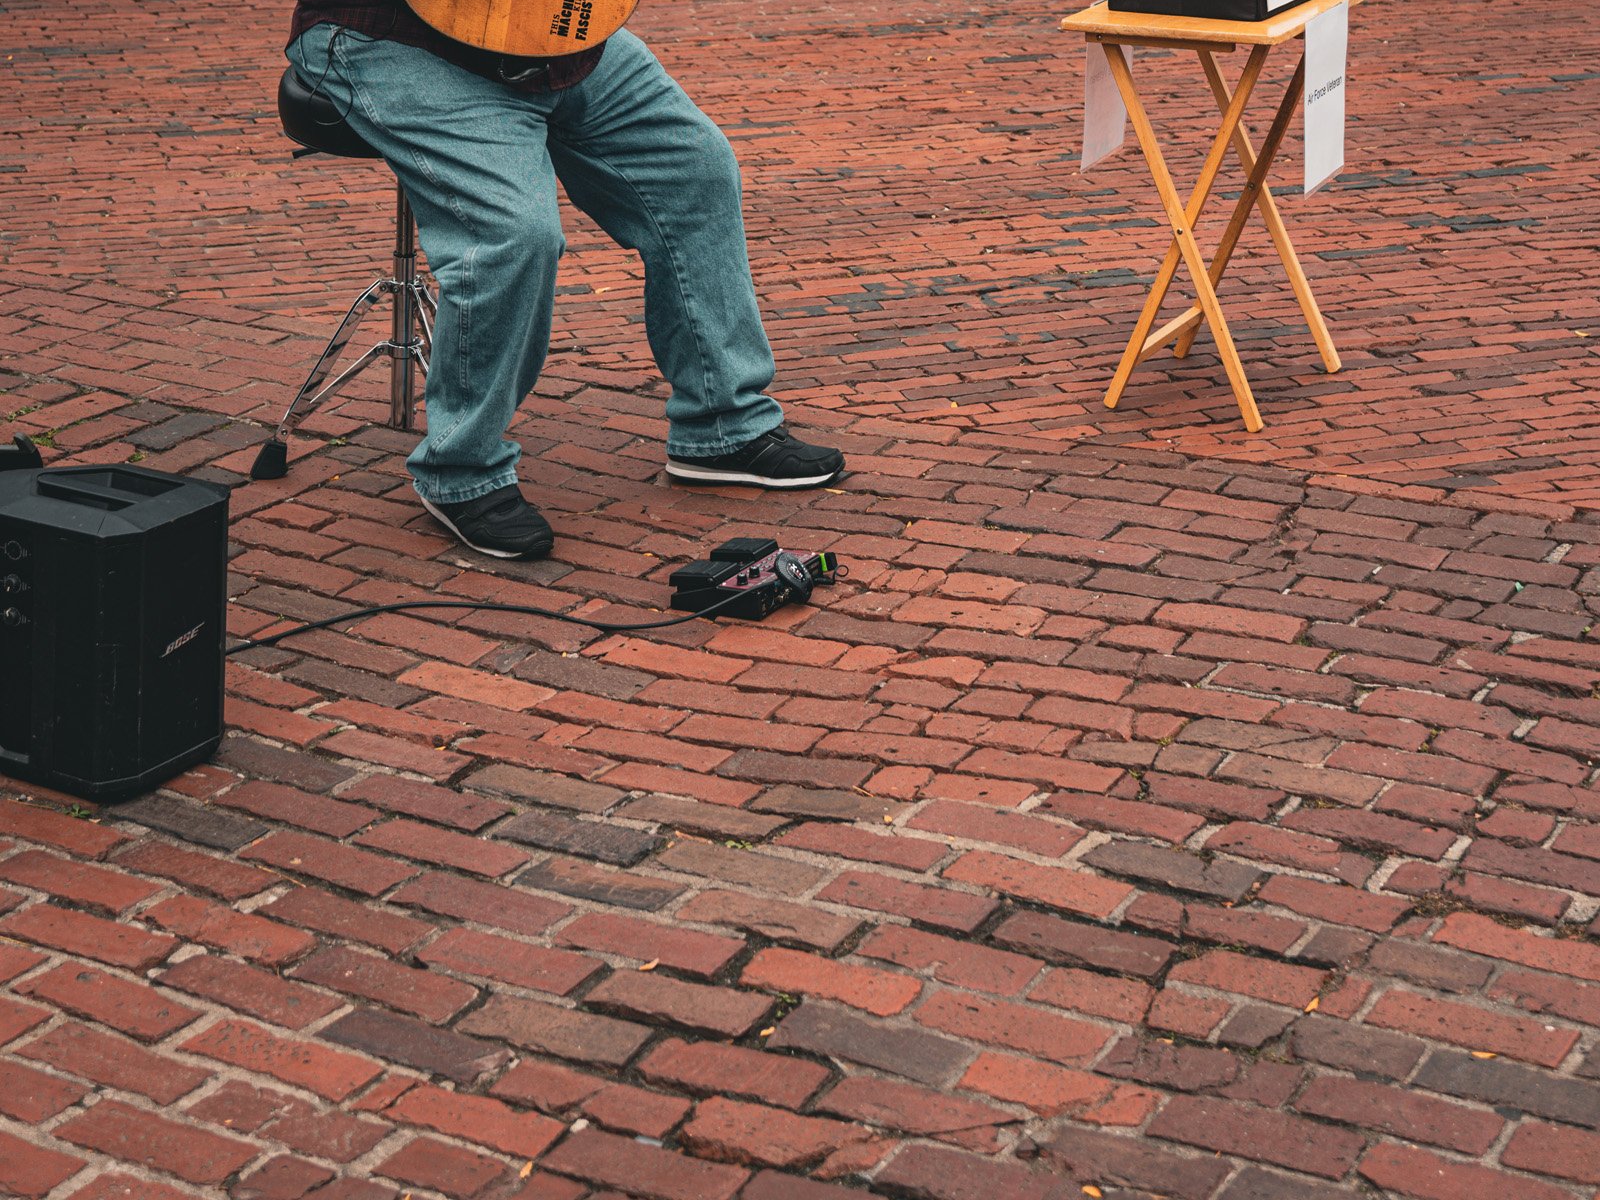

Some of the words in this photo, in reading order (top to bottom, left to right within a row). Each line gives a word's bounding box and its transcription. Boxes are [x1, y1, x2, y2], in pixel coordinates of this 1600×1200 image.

[550, 14, 560, 35] THIS
[1314, 86, 1326, 101] Force
[1326, 76, 1343, 92] Veteran
[161, 621, 205, 658] BOSE
